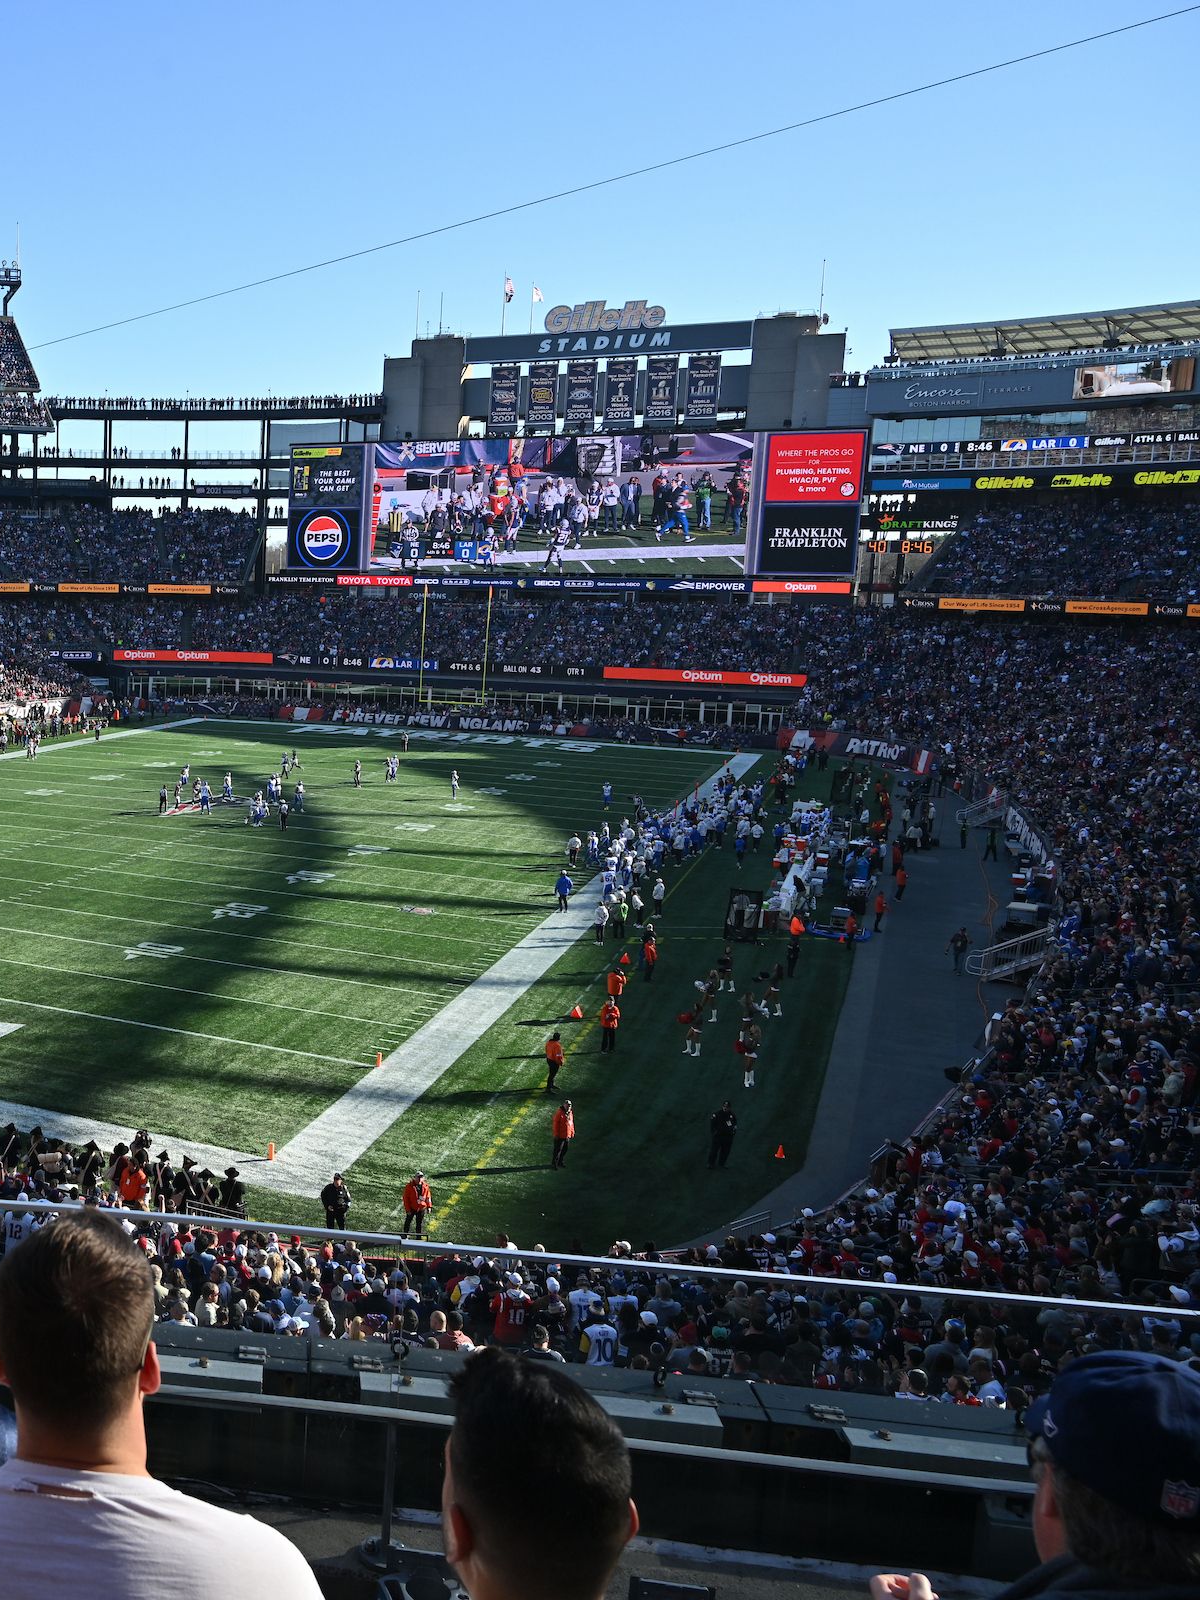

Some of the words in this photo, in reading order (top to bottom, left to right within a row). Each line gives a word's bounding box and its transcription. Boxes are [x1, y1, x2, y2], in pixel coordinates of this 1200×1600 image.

[544, 300, 666, 334] Gillette
[538, 332, 672, 353] STADIUM
[904, 383, 977, 400] Encore
[416, 441, 460, 453] SERVICE
[909, 445, 925, 453] NE
[967, 442, 992, 451] 8:46
[1032, 440, 1055, 449] LAR
[1069, 438, 1077, 446] 0
[776, 468, 815, 476] PLUMBING,
[817, 468, 852, 476] HEATING,
[790, 476, 820, 484] HVAC/R,
[975, 476, 1034, 489] Gillette
[880, 521, 957, 530] DRAFTKINGS
[307, 533, 340, 543] PEPSI
[775, 528, 842, 537] FRANKLIN
[769, 537, 847, 548] TEMPLETON
[869, 541, 886, 552] 40
[902, 541, 932, 553] 8:46
[410, 549, 418, 558] 0
[462, 549, 469, 558] 0
[785, 583, 816, 592] Optum
[124, 650, 155, 659] Optum
[177, 651, 209, 660] Optum
[682, 670, 722, 682] Optum
[750, 673, 792, 684] Optum
[288, 725, 601, 752] PATRIOTS
[10, 1223, 22, 1239] 12
[510, 1308, 524, 1325] 10
[596, 1338, 614, 1362] 10
